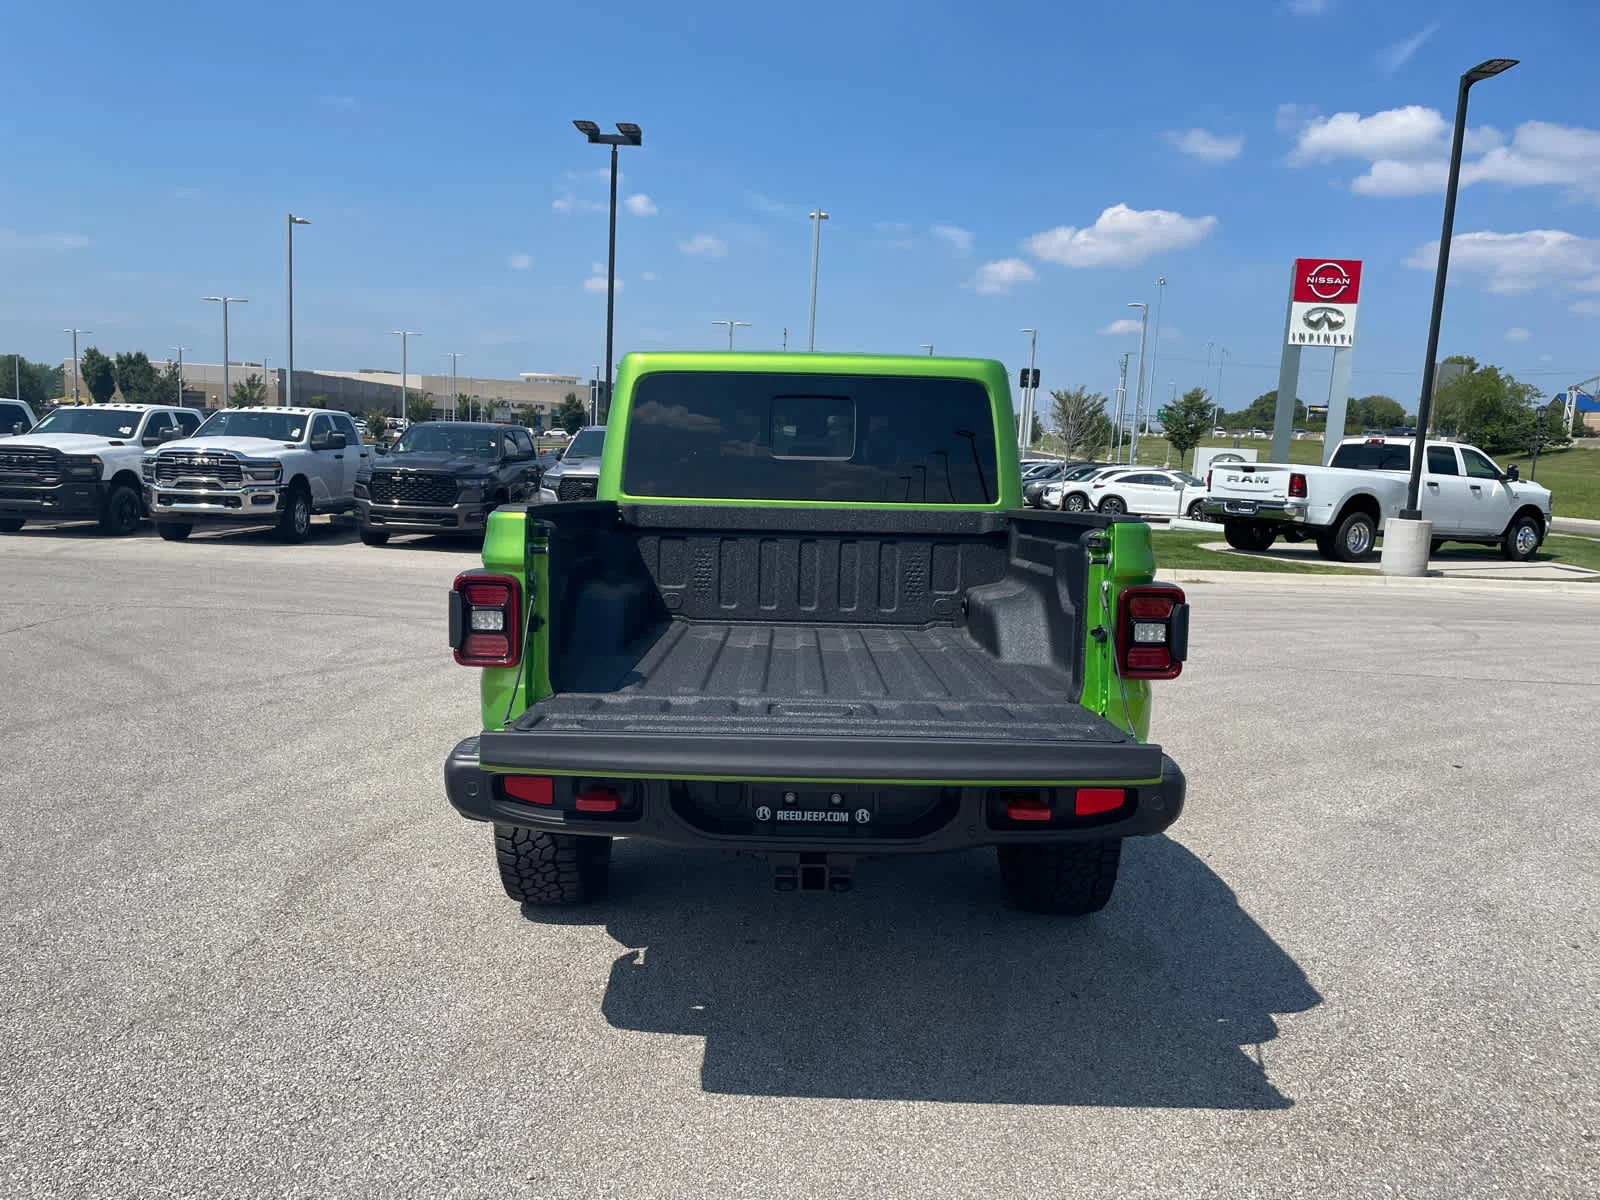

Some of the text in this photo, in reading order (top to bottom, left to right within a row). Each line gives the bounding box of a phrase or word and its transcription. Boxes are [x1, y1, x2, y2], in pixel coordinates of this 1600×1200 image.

[1306, 276, 1350, 285] NISSAN
[1292, 332, 1352, 345] INFINITI
[1226, 475, 1269, 484] RAM
[776, 810, 849, 822] REEDJEEP.COM
